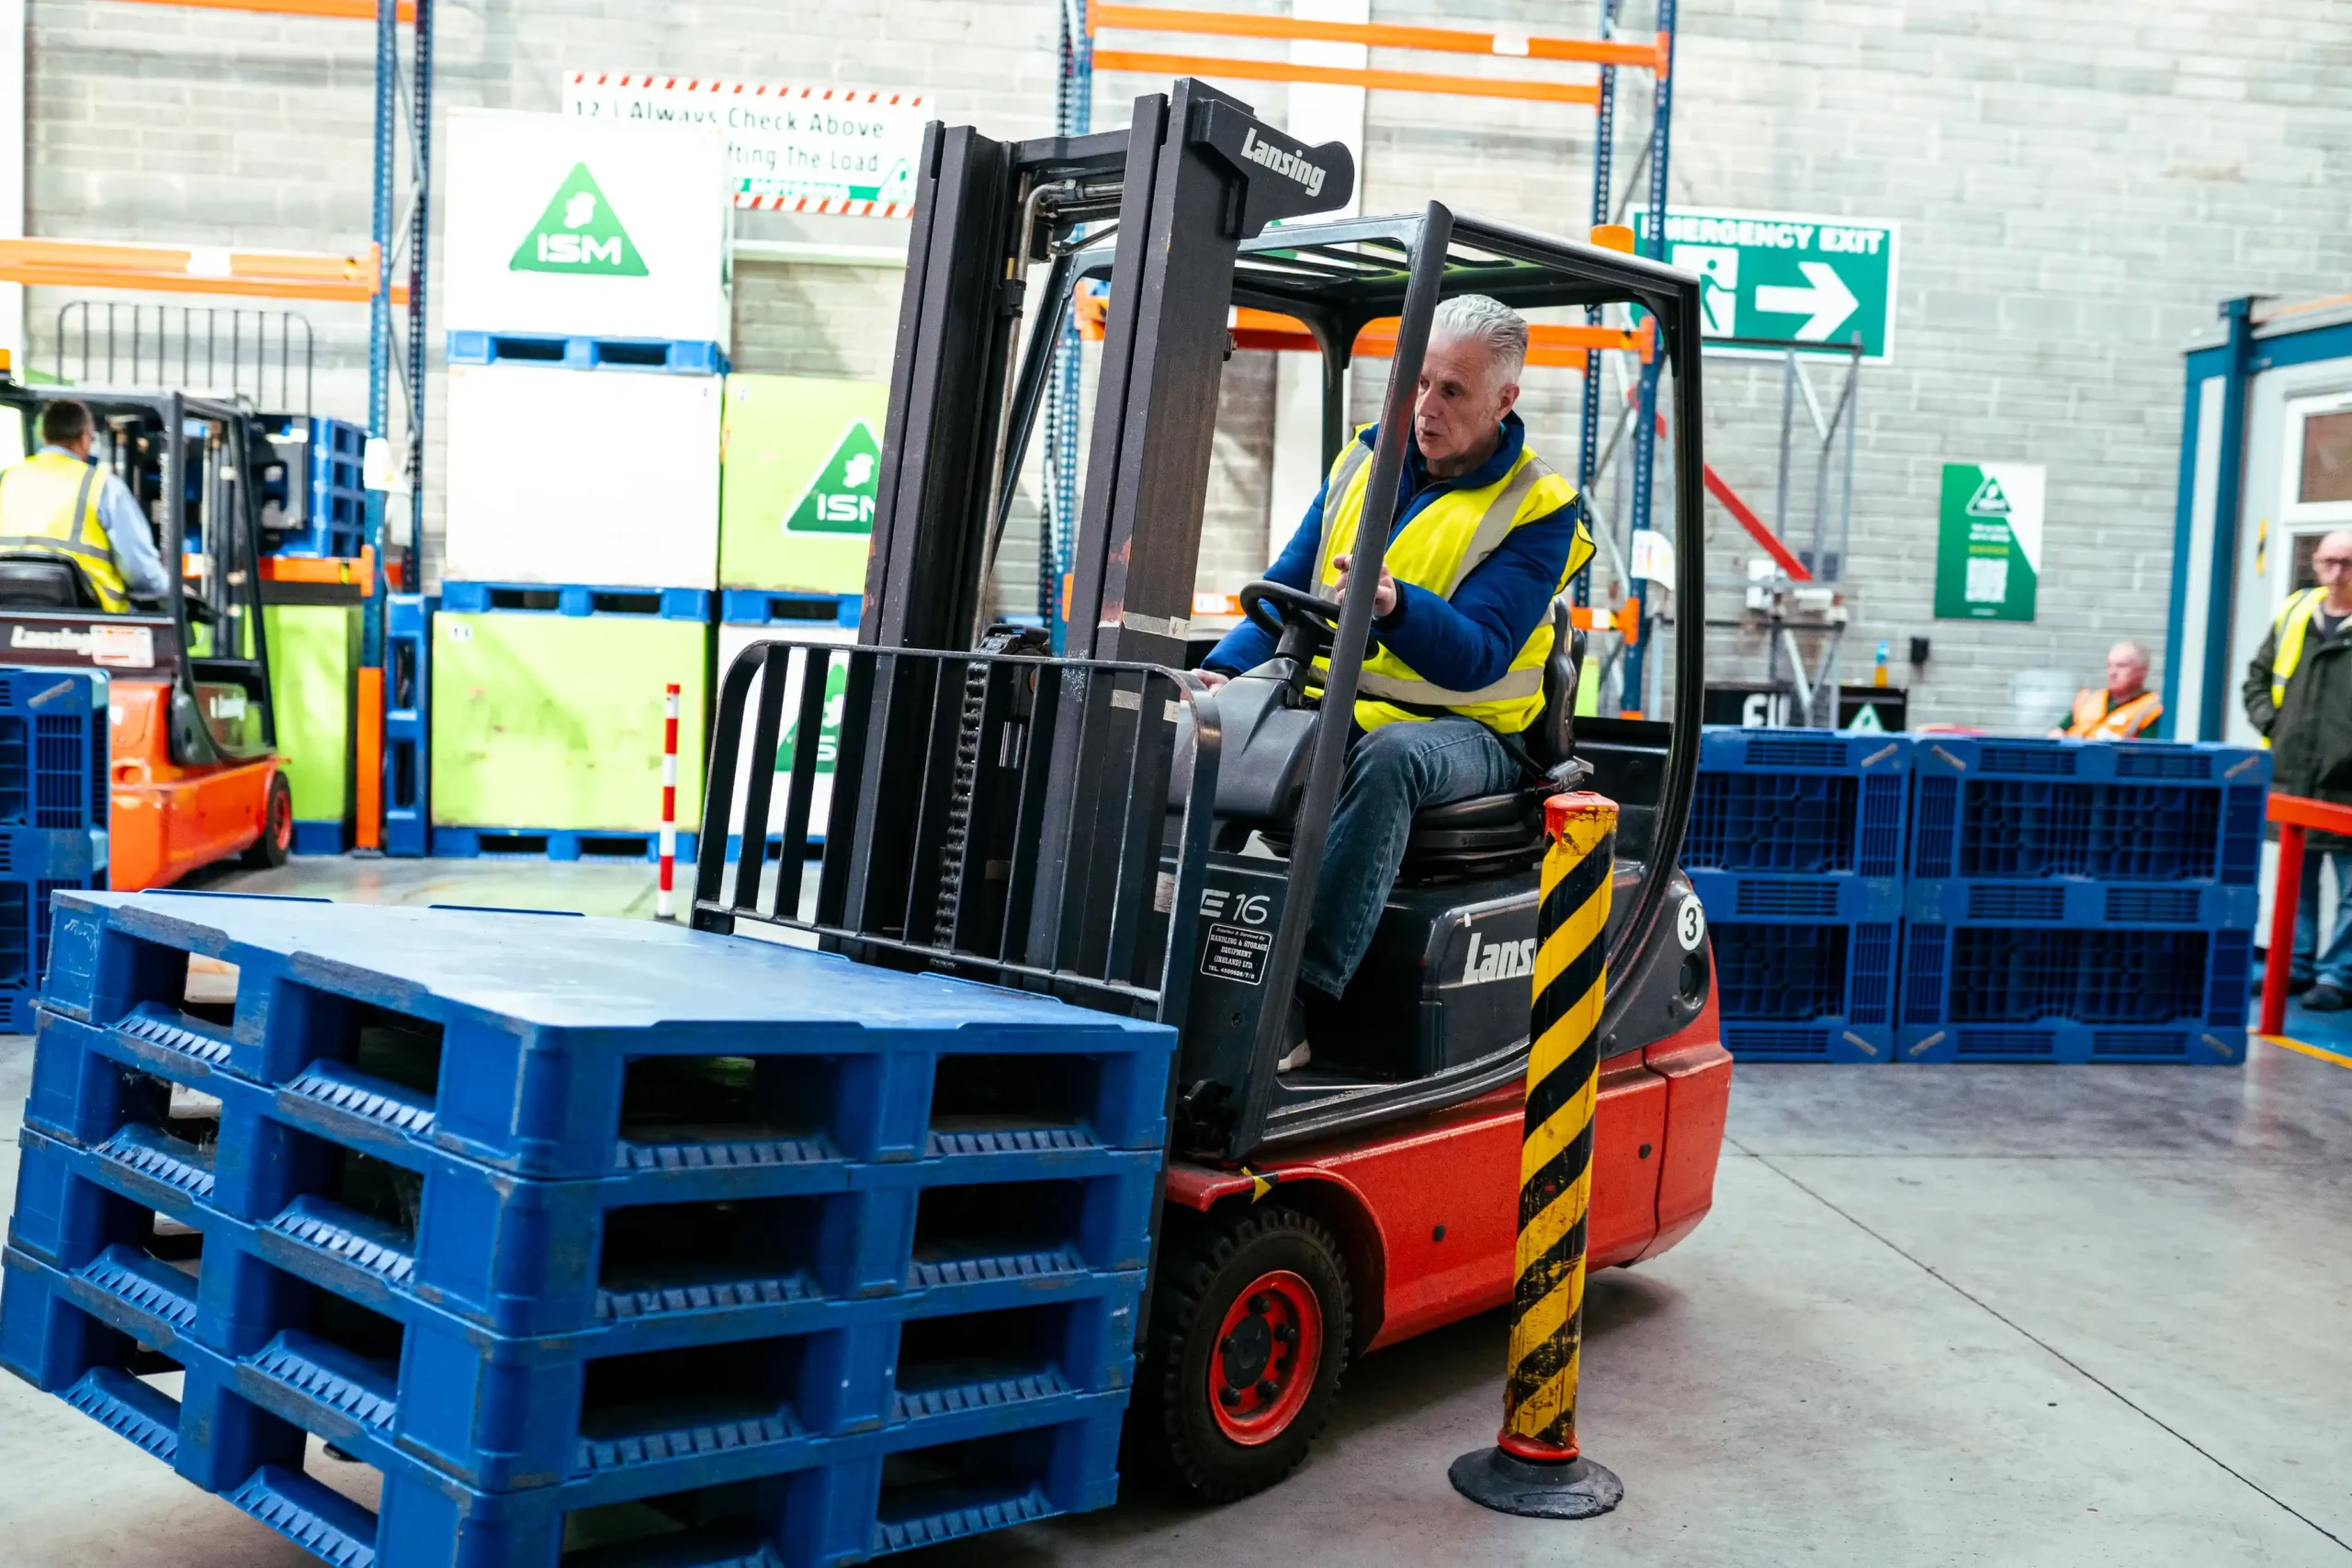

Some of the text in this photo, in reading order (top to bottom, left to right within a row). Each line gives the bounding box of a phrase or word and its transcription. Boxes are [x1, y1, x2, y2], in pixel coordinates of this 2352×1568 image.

[729, 107, 797, 130] Check
[809, 113, 884, 139] Above
[787, 146, 820, 169] The
[831, 150, 878, 172] Load
[1240, 127, 1327, 197] Lansing
[537, 232, 622, 265] ISM
[1818, 226, 1883, 254] EXIT
[1199, 888, 1271, 925] E 16
[1239, 931, 1259, 940] Serviced
[1685, 907, 1698, 942] 3
[1210, 934, 1238, 945] HANDLING
[1243, 940, 1268, 952] STORAGE
[1220, 946, 1252, 958] EQUIPMENT
[1214, 954, 1241, 967] (IRELAND)
[1462, 932, 1537, 986] Lans
